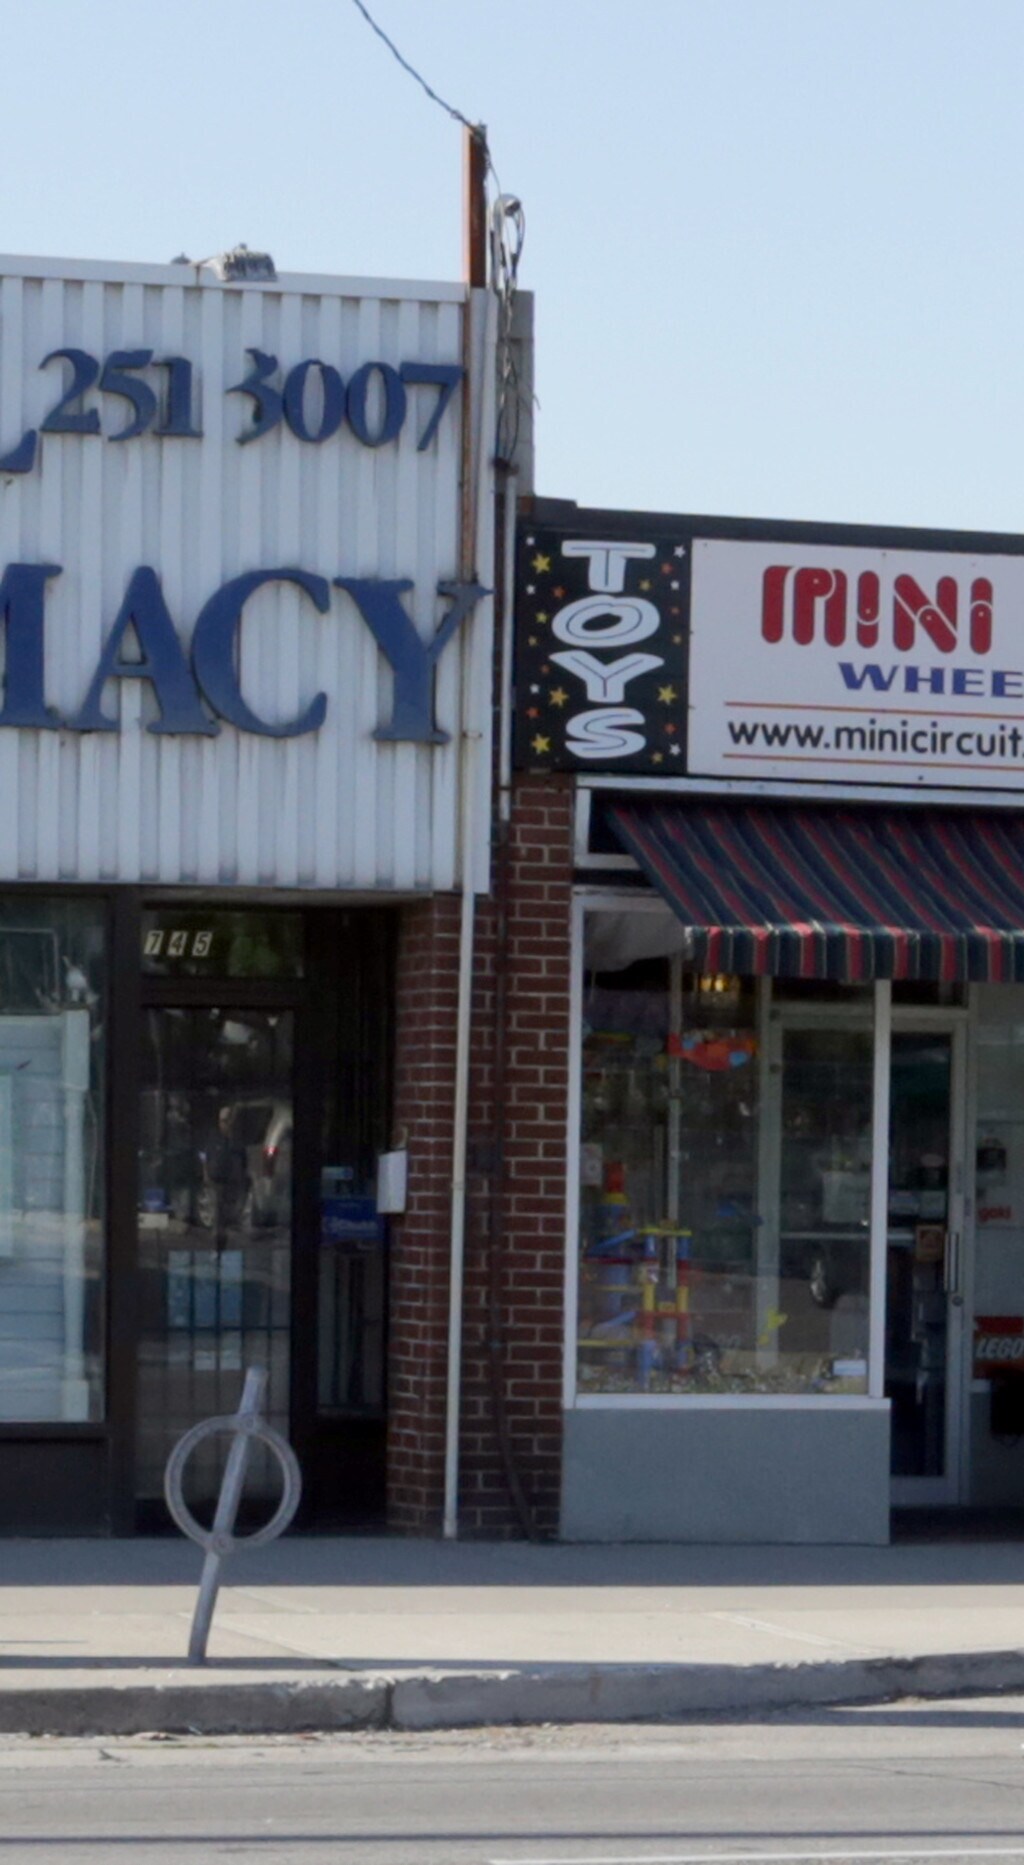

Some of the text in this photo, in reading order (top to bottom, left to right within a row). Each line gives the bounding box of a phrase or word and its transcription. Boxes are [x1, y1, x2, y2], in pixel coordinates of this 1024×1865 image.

[39, 347, 466, 452] 251 3007
[549, 540, 665, 760] TOYS
[761, 564, 994, 655] MINI
[148, 931, 209, 955] 745
